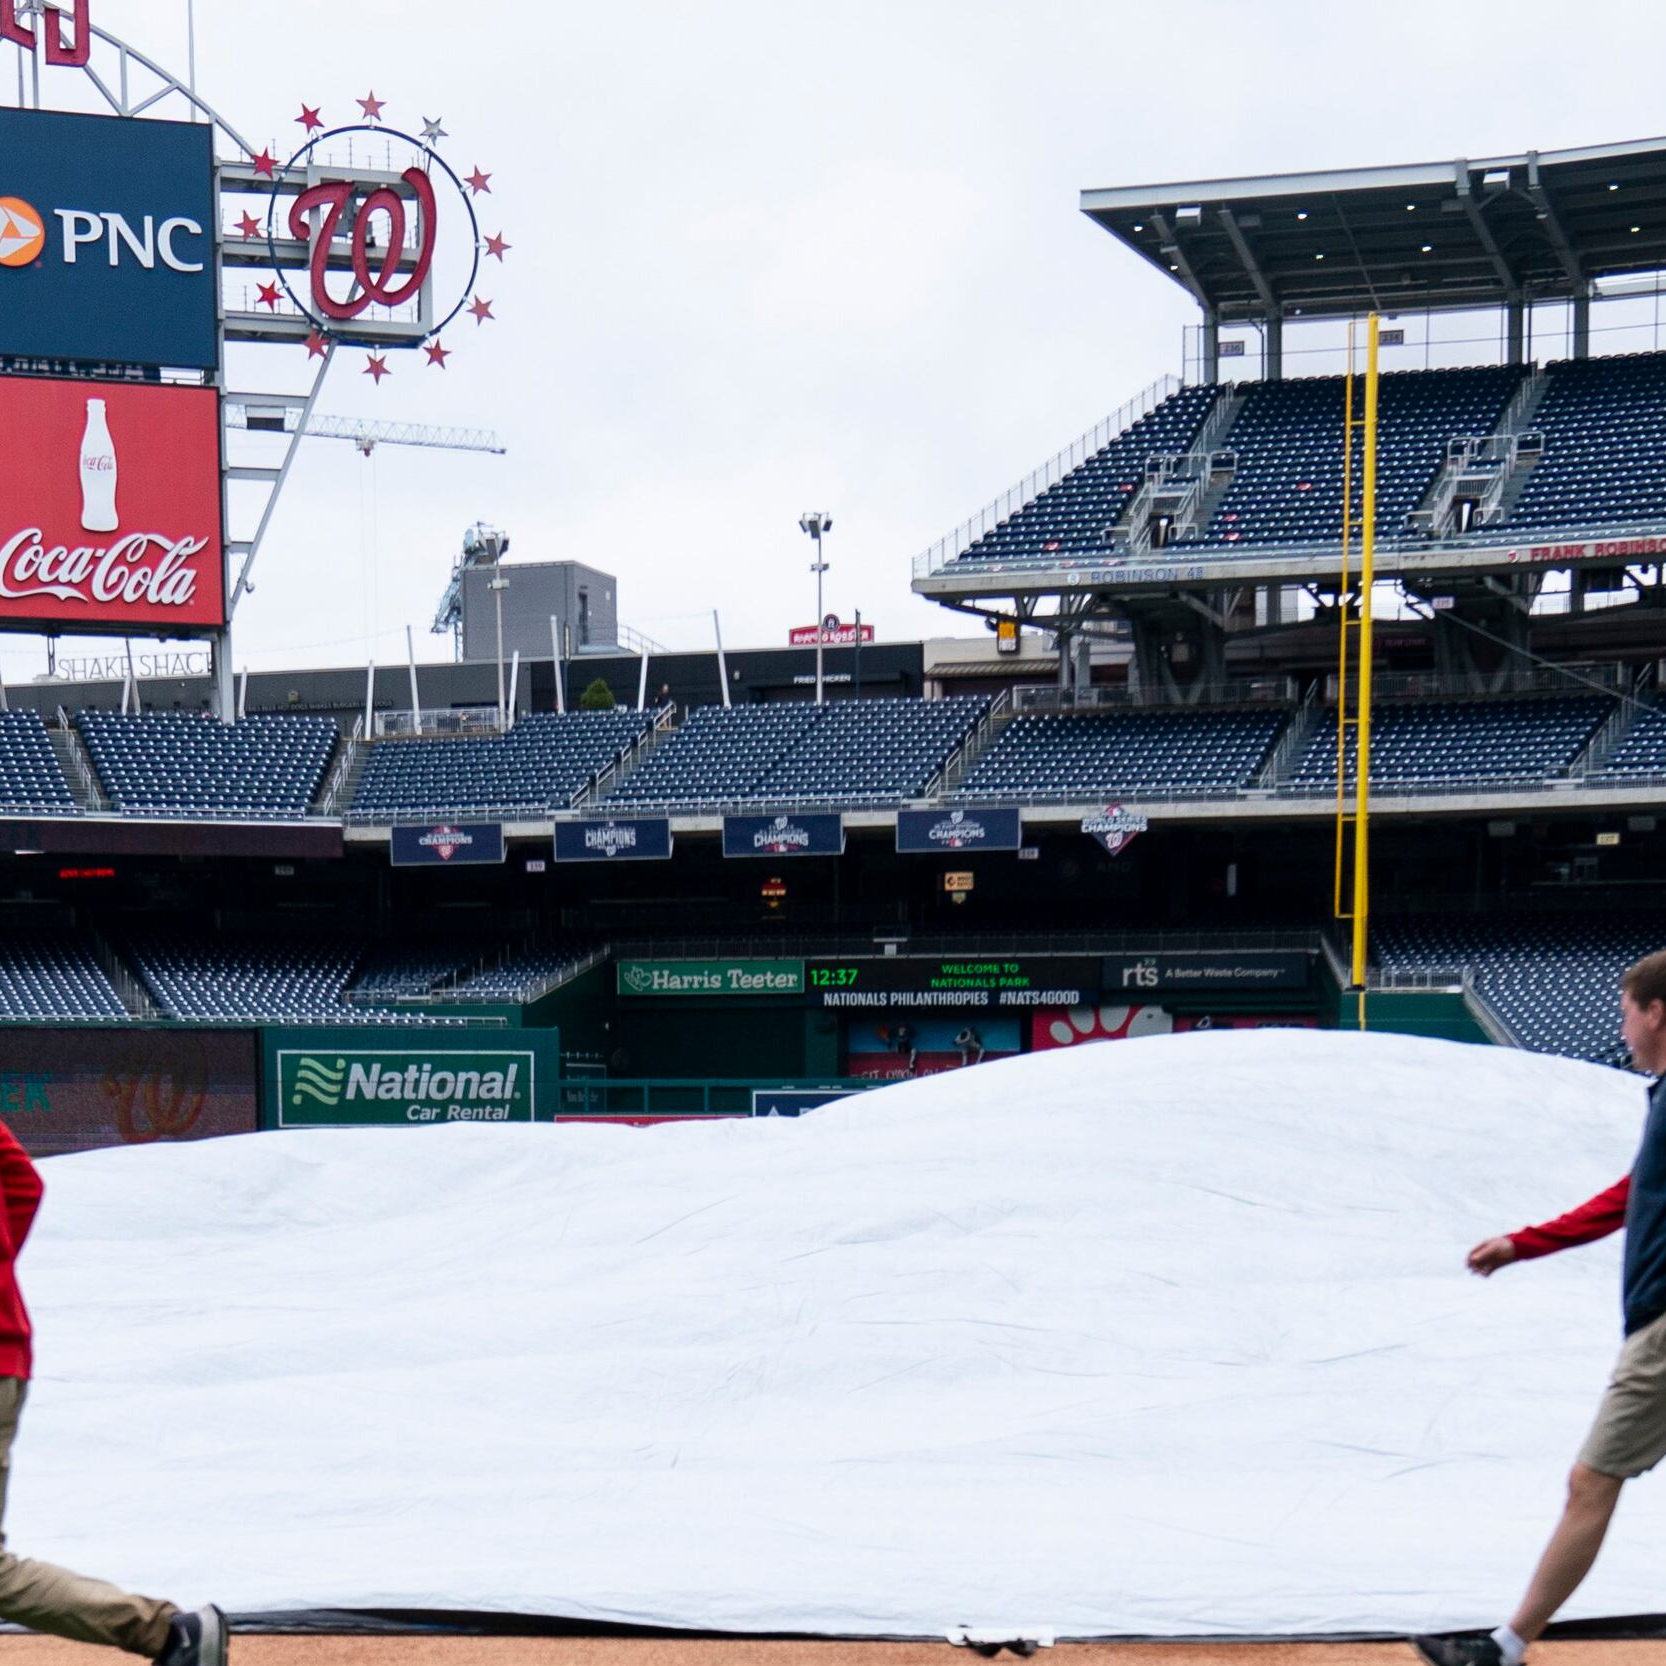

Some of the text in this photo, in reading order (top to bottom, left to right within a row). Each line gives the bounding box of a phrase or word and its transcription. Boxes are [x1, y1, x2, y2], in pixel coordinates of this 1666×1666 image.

[53, 207, 205, 274] PNC
[1530, 544, 1584, 562] FRANK
[1090, 568, 1178, 584] ROBINSON
[58, 656, 130, 681] SHAKE
[929, 827, 986, 840] CHAMPIONS
[1081, 824, 1148, 833] CHAMPIONS
[419, 835, 473, 845] CHAMPIONS
[585, 829, 636, 848] CHAMPIONS
[754, 833, 809, 848] CHAMPIONS
[811, 968, 859, 986] 12:37
[942, 962, 1020, 976] WELCOME TO
[1122, 962, 1159, 987] rts
[1175, 968, 1202, 978] Better
[1203, 968, 1232, 978] Waste
[652, 968, 799, 990] Harris Teeter
[930, 977, 1030, 988] NATIONALS PARK
[824, 989, 1080, 1007] NATIONALS PHILANTHROPIES #NATS4GOOD
[346, 1062, 517, 1100] National
[406, 1104, 510, 1121] Car Rental
